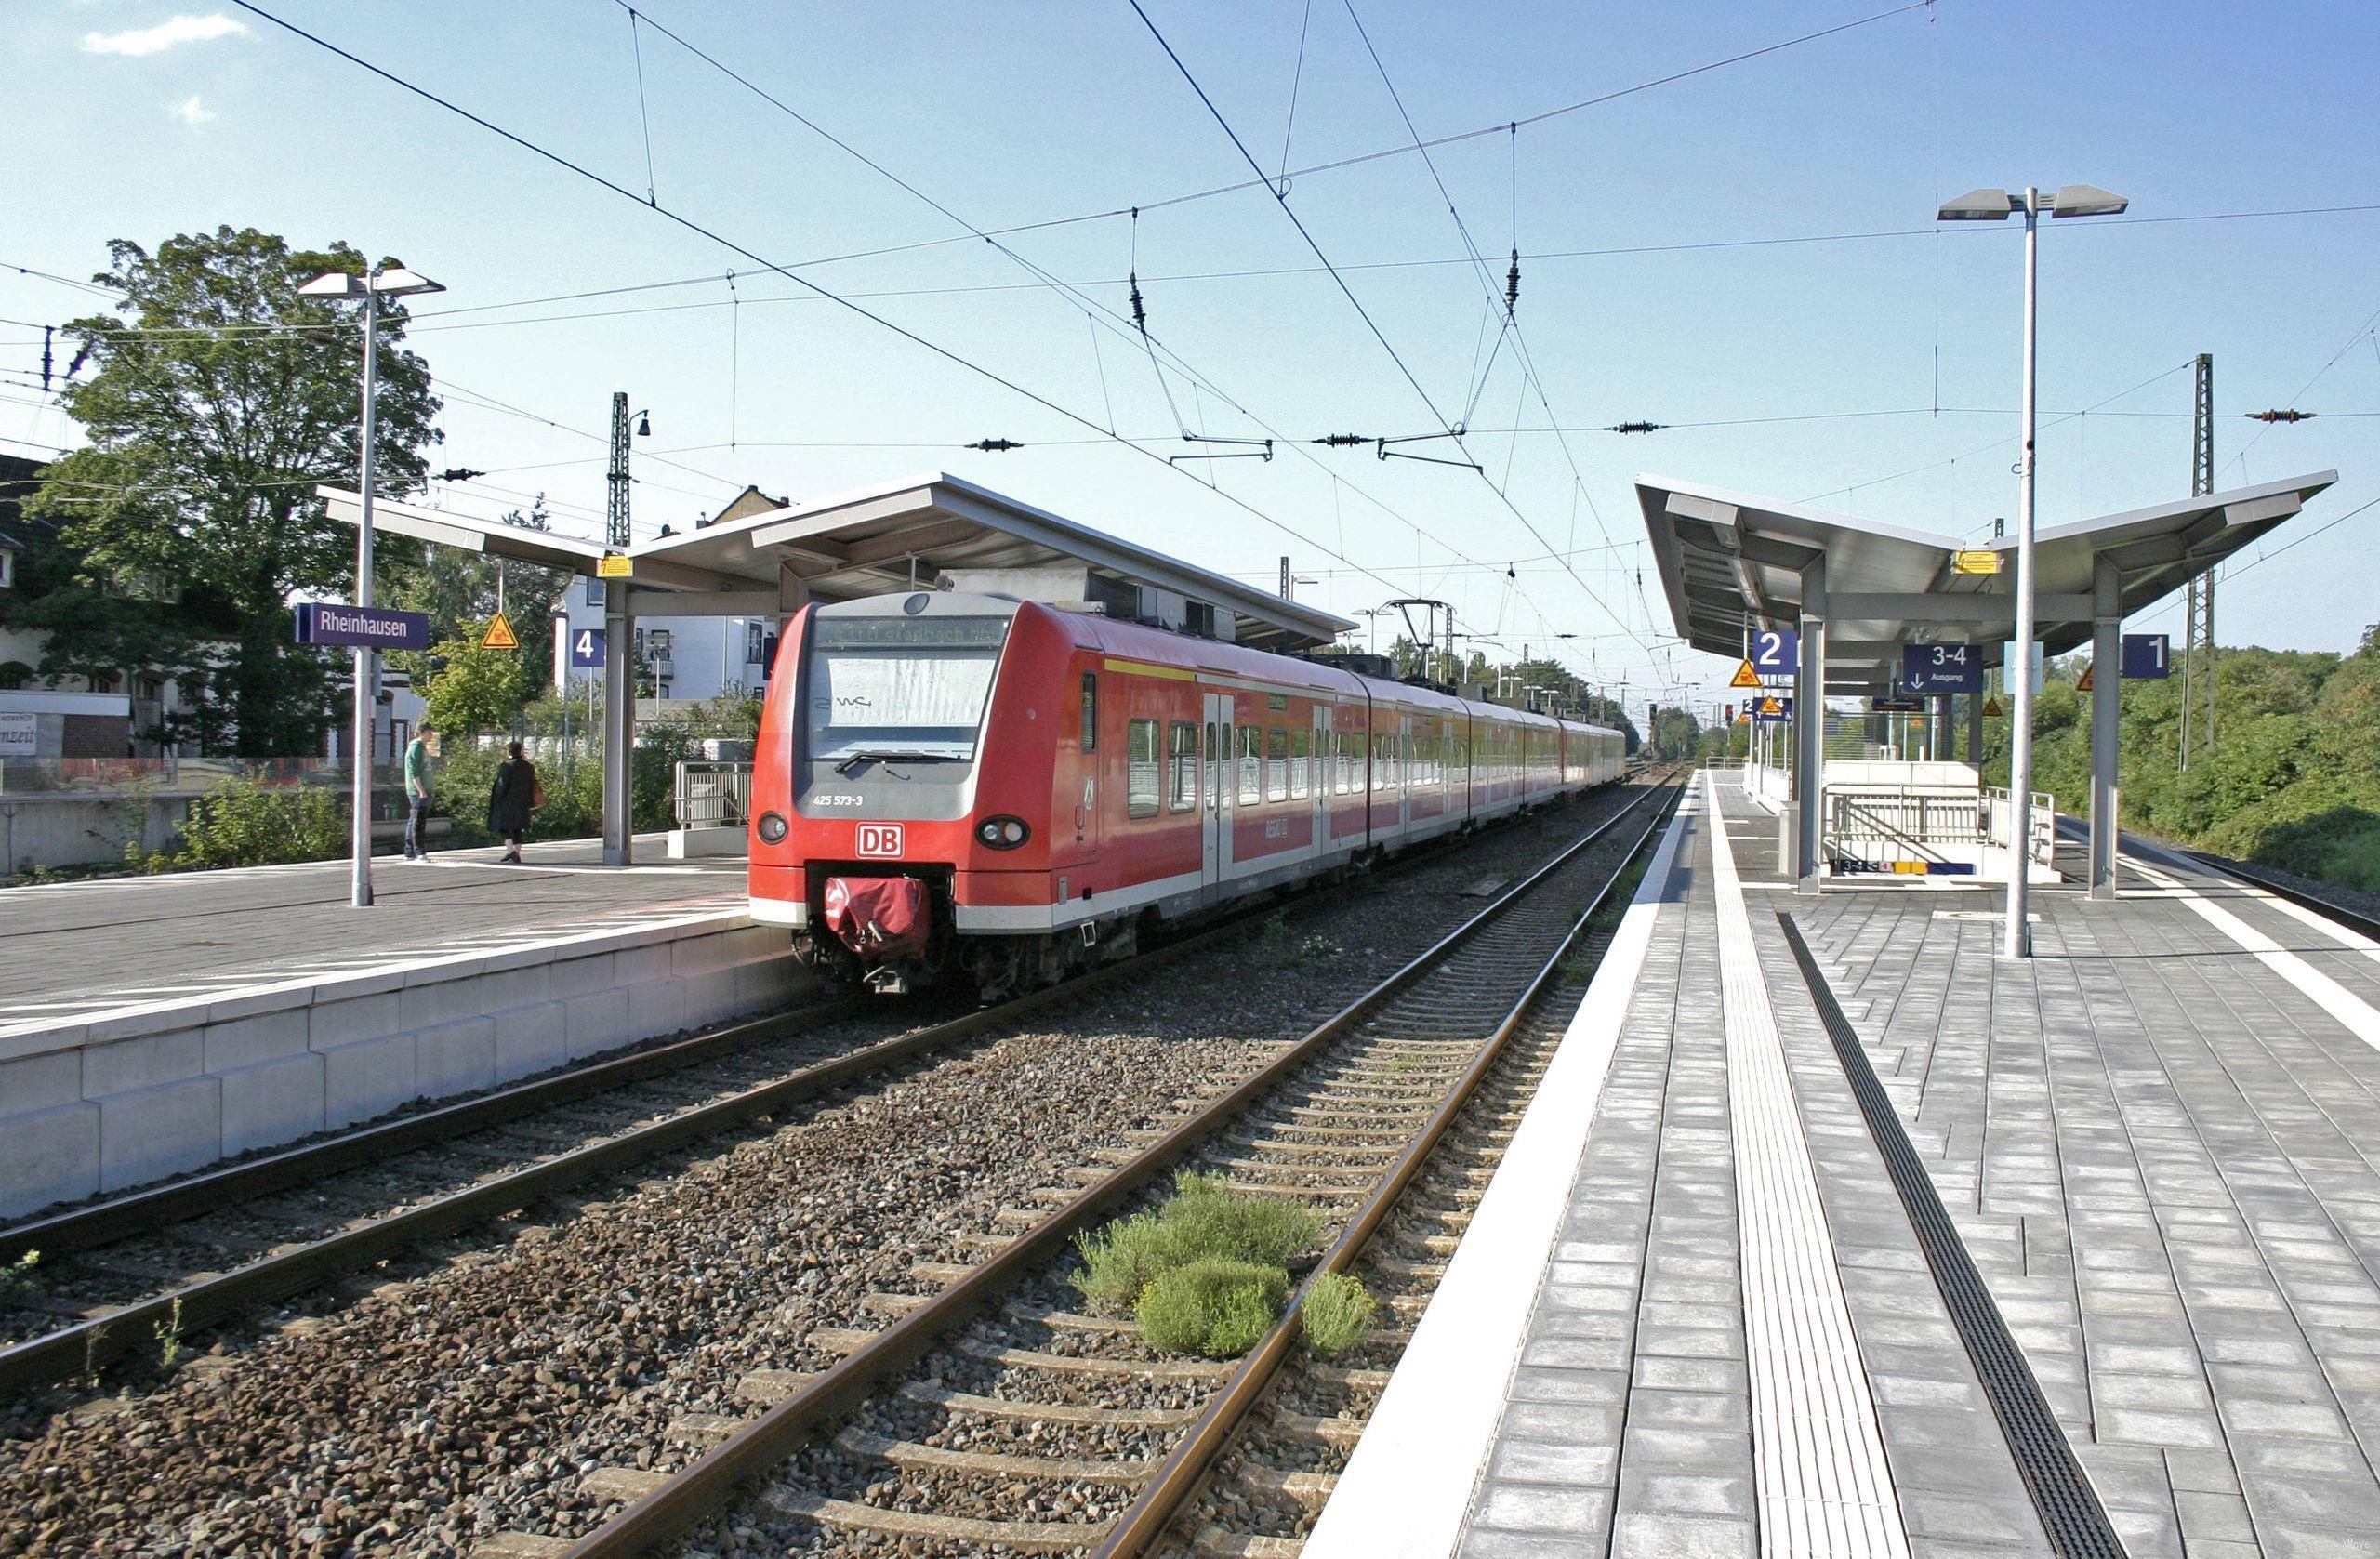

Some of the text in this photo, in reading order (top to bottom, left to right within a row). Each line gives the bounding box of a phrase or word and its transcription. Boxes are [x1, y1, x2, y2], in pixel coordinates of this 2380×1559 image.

[321, 610, 407, 638] Rheinhausen
[576, 630, 594, 658] 4
[1759, 632, 1781, 665] 2
[1932, 646, 1967, 665] 3-4
[2149, 636, 2163, 668] 1
[1930, 673, 1964, 682] Ausgang
[1744, 699, 1753, 712] 2
[813, 795, 864, 806] 425 573-3
[863, 828, 898, 852] DB
